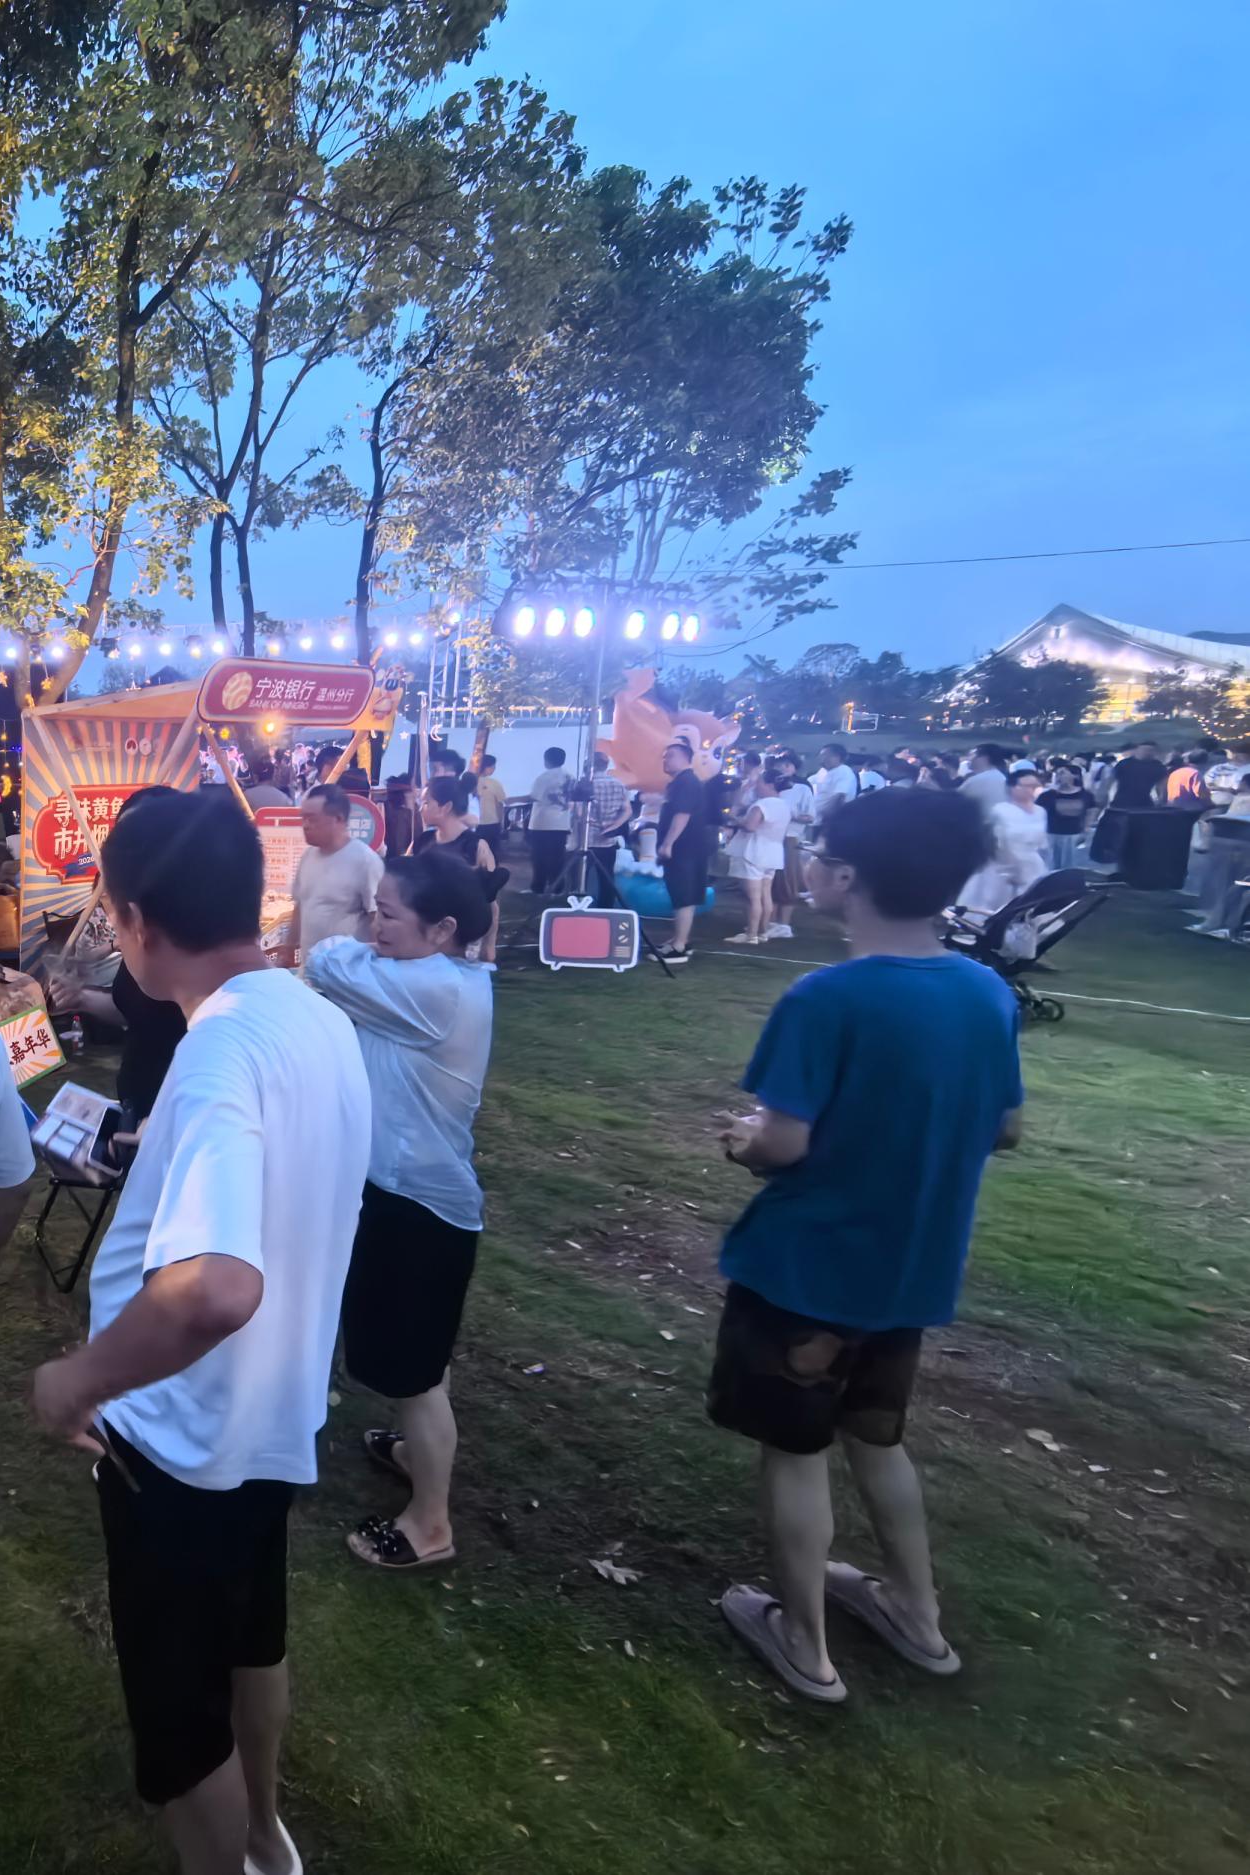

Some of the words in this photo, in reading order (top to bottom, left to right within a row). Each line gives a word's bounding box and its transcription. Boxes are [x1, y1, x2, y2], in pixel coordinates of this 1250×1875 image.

[255, 677, 317, 701] 宁波银行
[316, 687, 356, 703] 温州分行
[9, 1028, 52, 1065] 嘉年华
